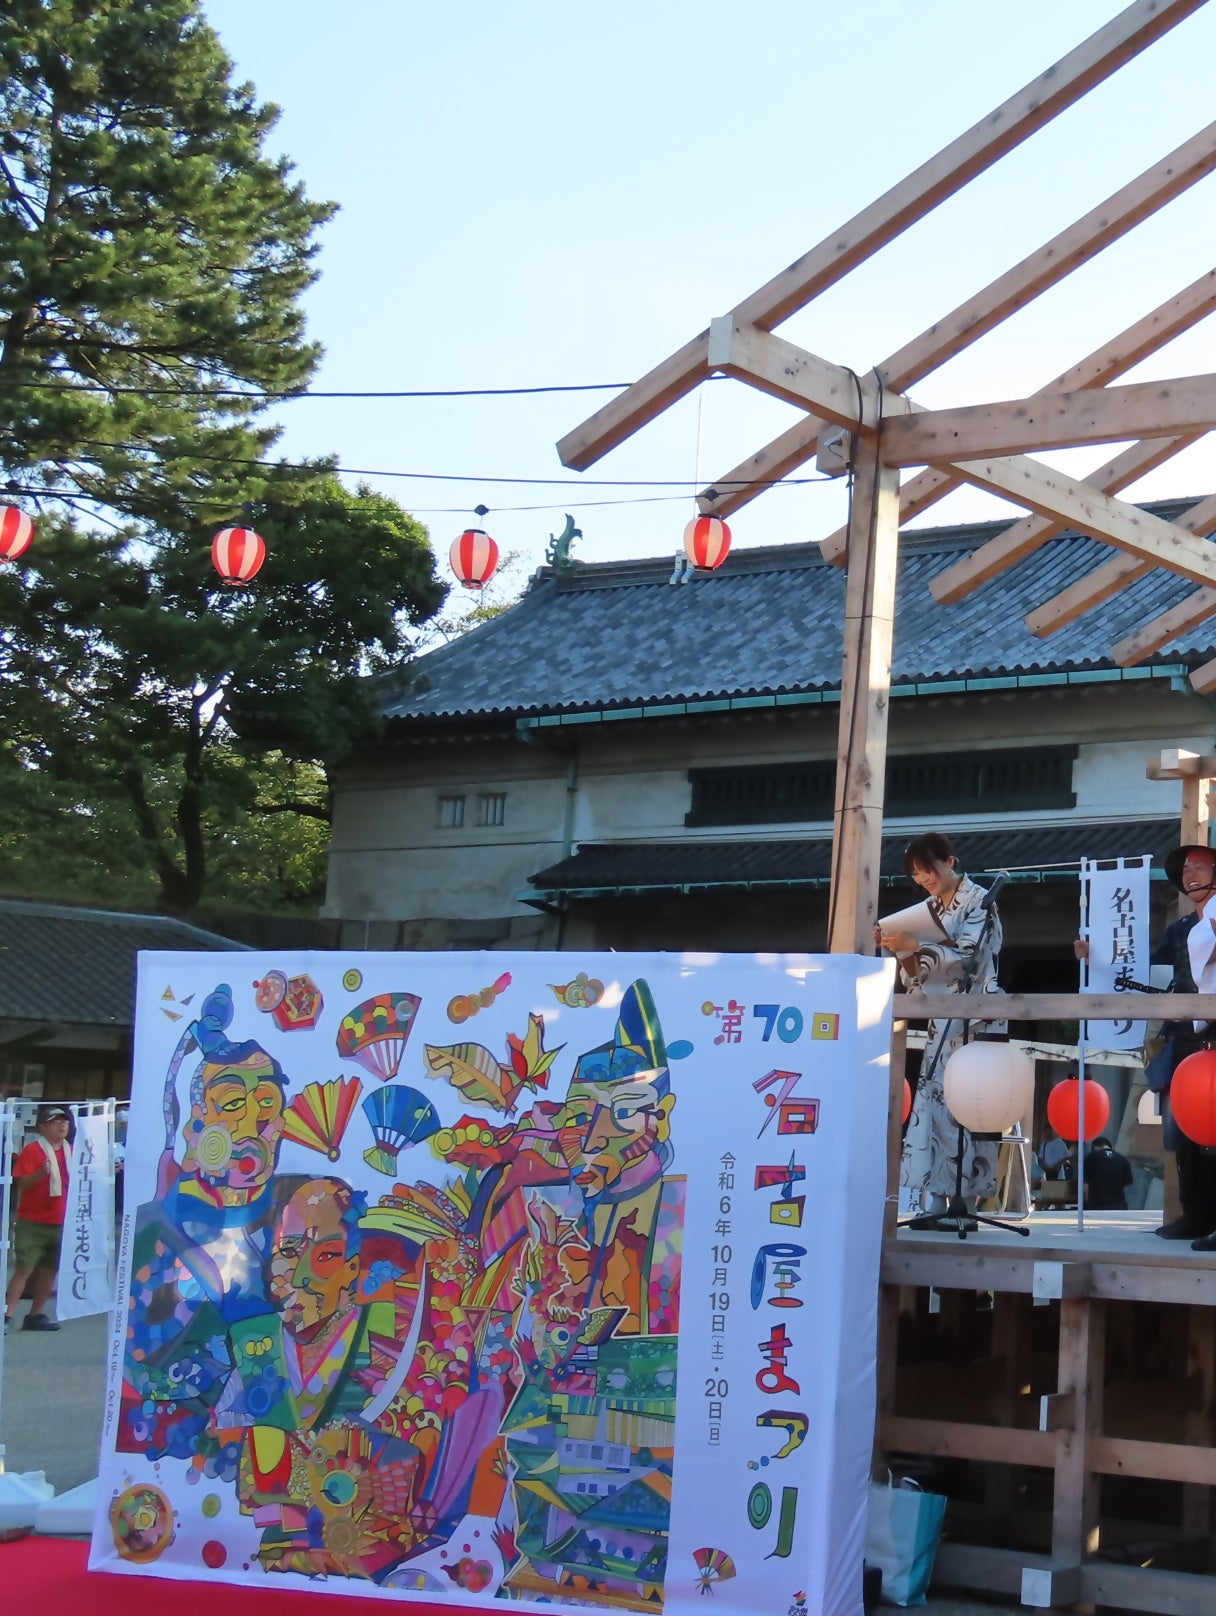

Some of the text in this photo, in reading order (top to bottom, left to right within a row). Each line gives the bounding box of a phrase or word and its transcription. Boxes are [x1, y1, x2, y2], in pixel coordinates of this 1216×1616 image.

[1110, 887, 1136, 1036] 名古屋まり
[701, 999, 840, 1045] 第70回
[121, 1214, 131, 1257] NAGOYA
[117, 1260, 127, 1305] FESTIVAL
[747, 1069, 820, 1560] 名古屋まつり
